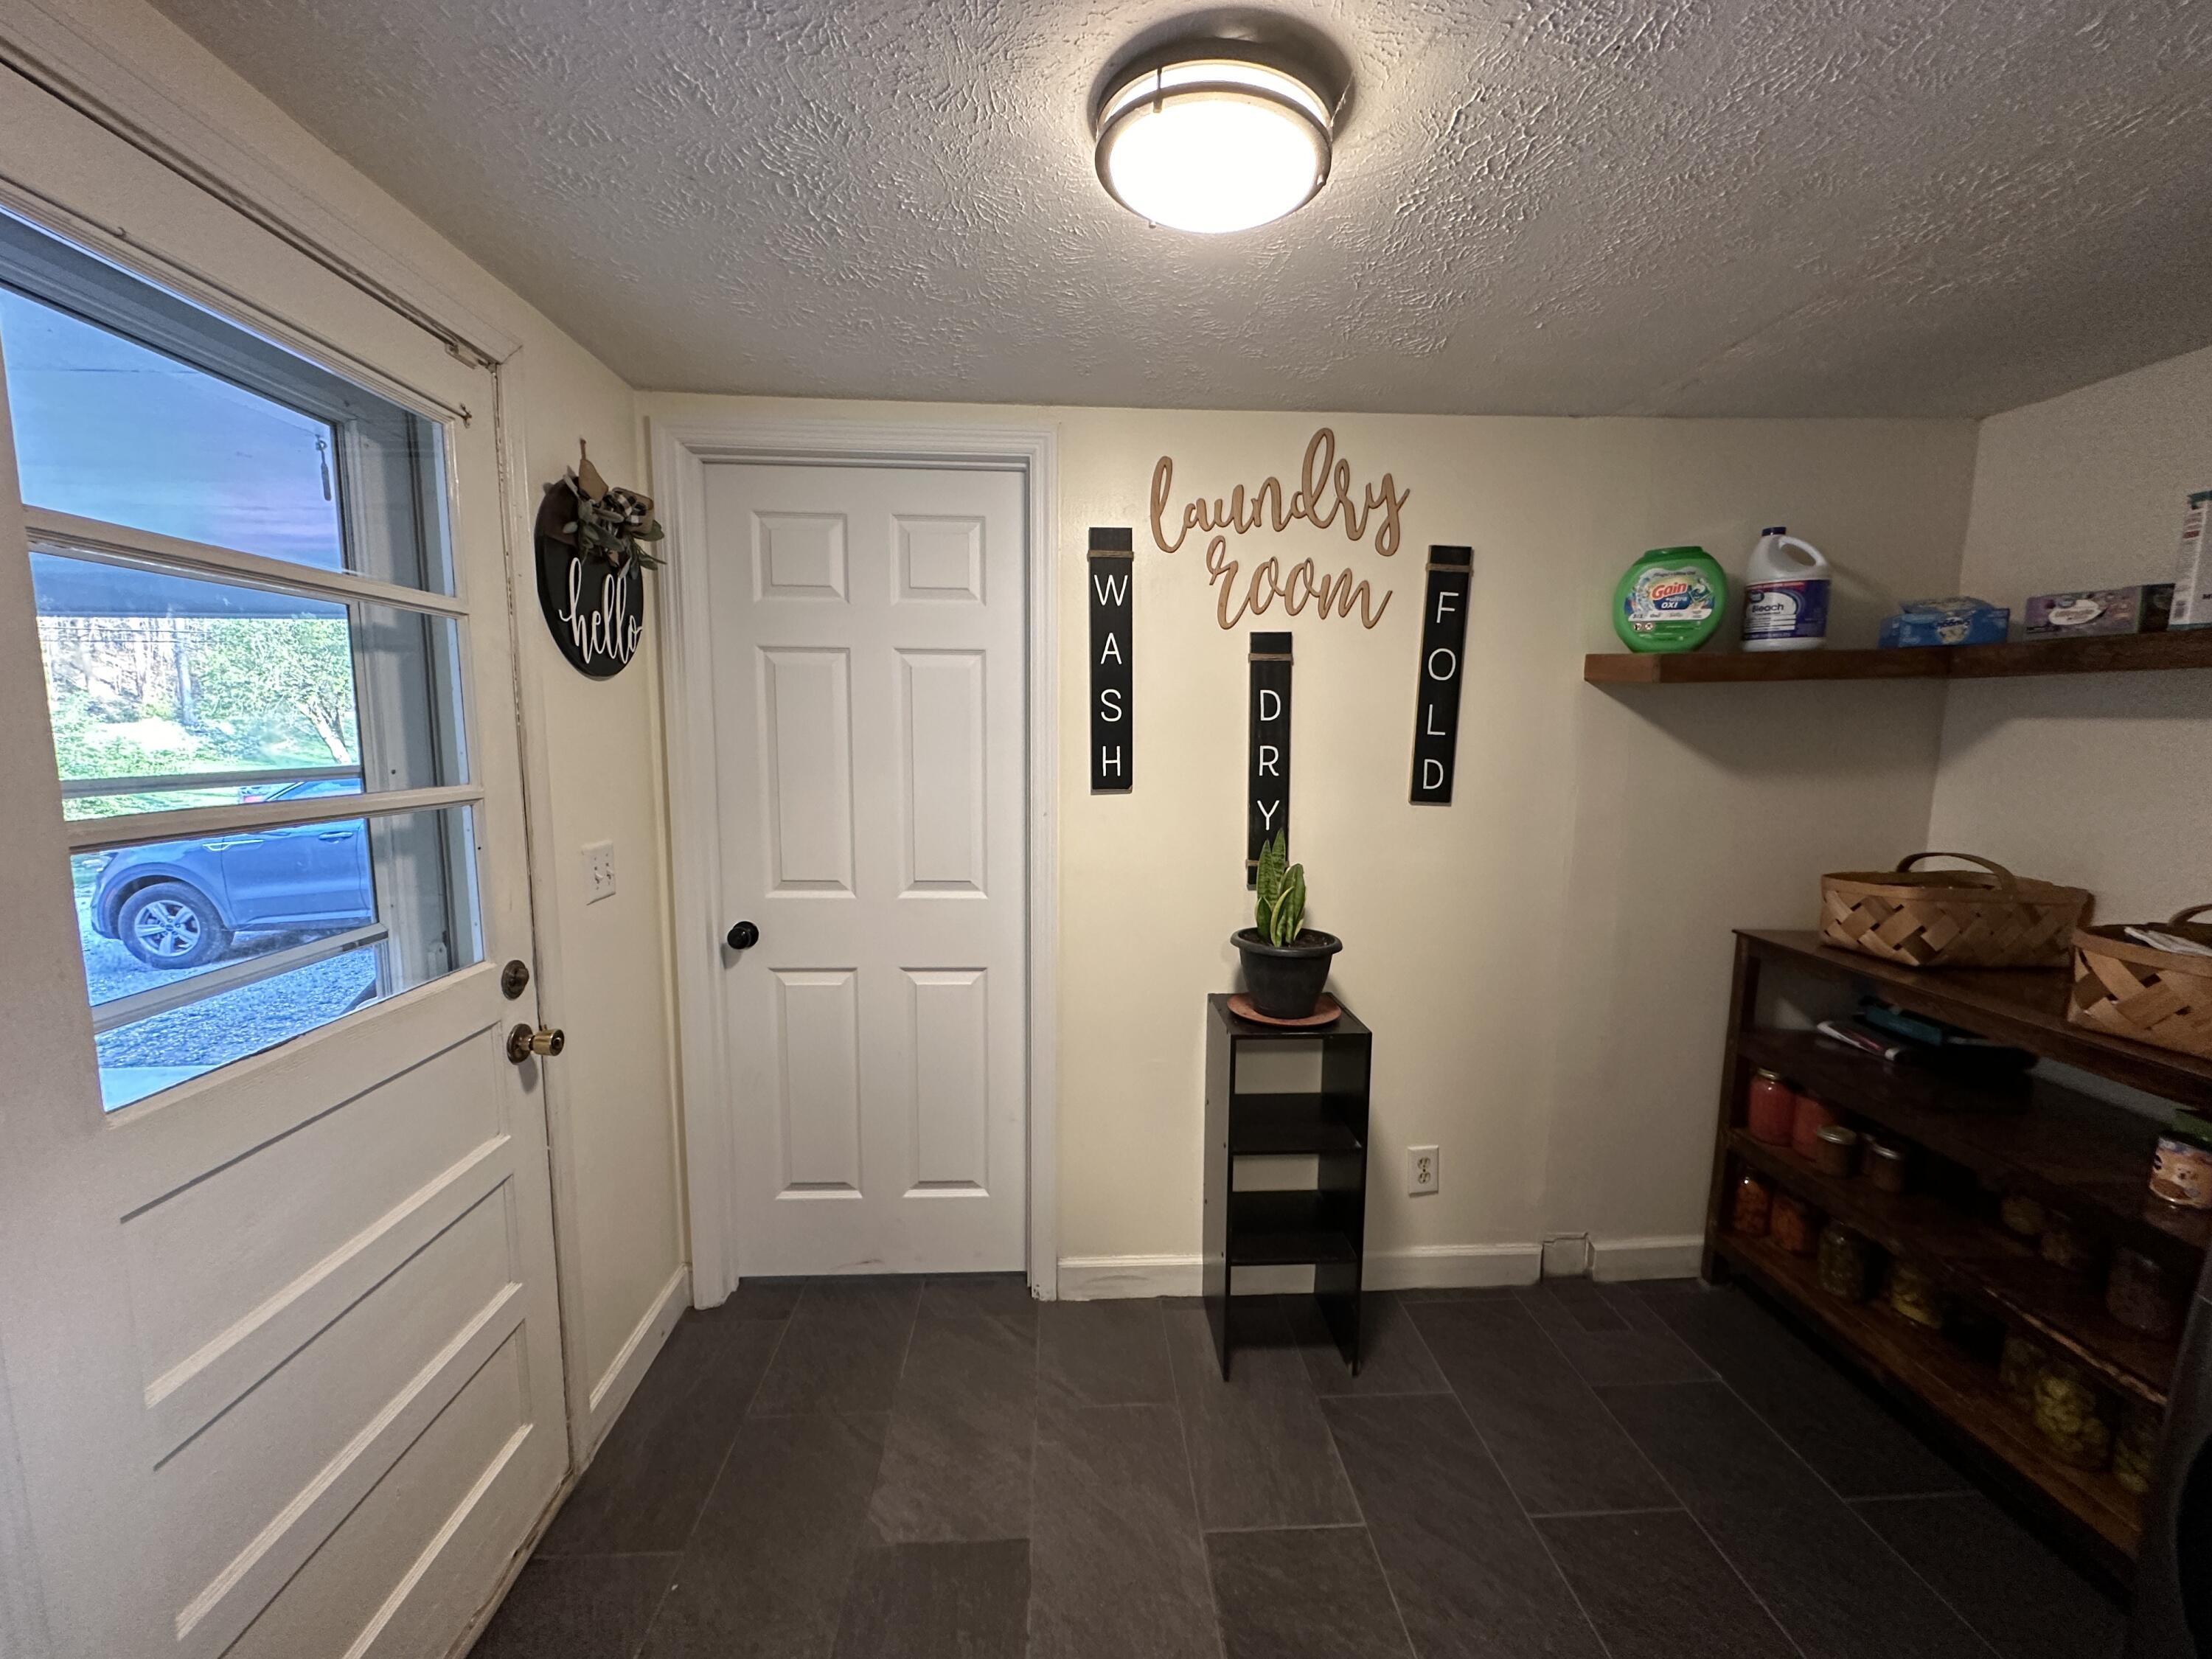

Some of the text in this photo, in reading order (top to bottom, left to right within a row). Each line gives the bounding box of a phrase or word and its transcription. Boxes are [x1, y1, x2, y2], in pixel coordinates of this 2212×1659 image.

[1150, 426, 1411, 557] laundry
[558, 557, 644, 664] hello
[1206, 535, 1393, 630] room
[1652, 581, 1687, 599] Gain
[1093, 574, 1129, 776] WASH
[1422, 591, 1459, 790] FOLD
[1256, 689, 1281, 831] DRY
